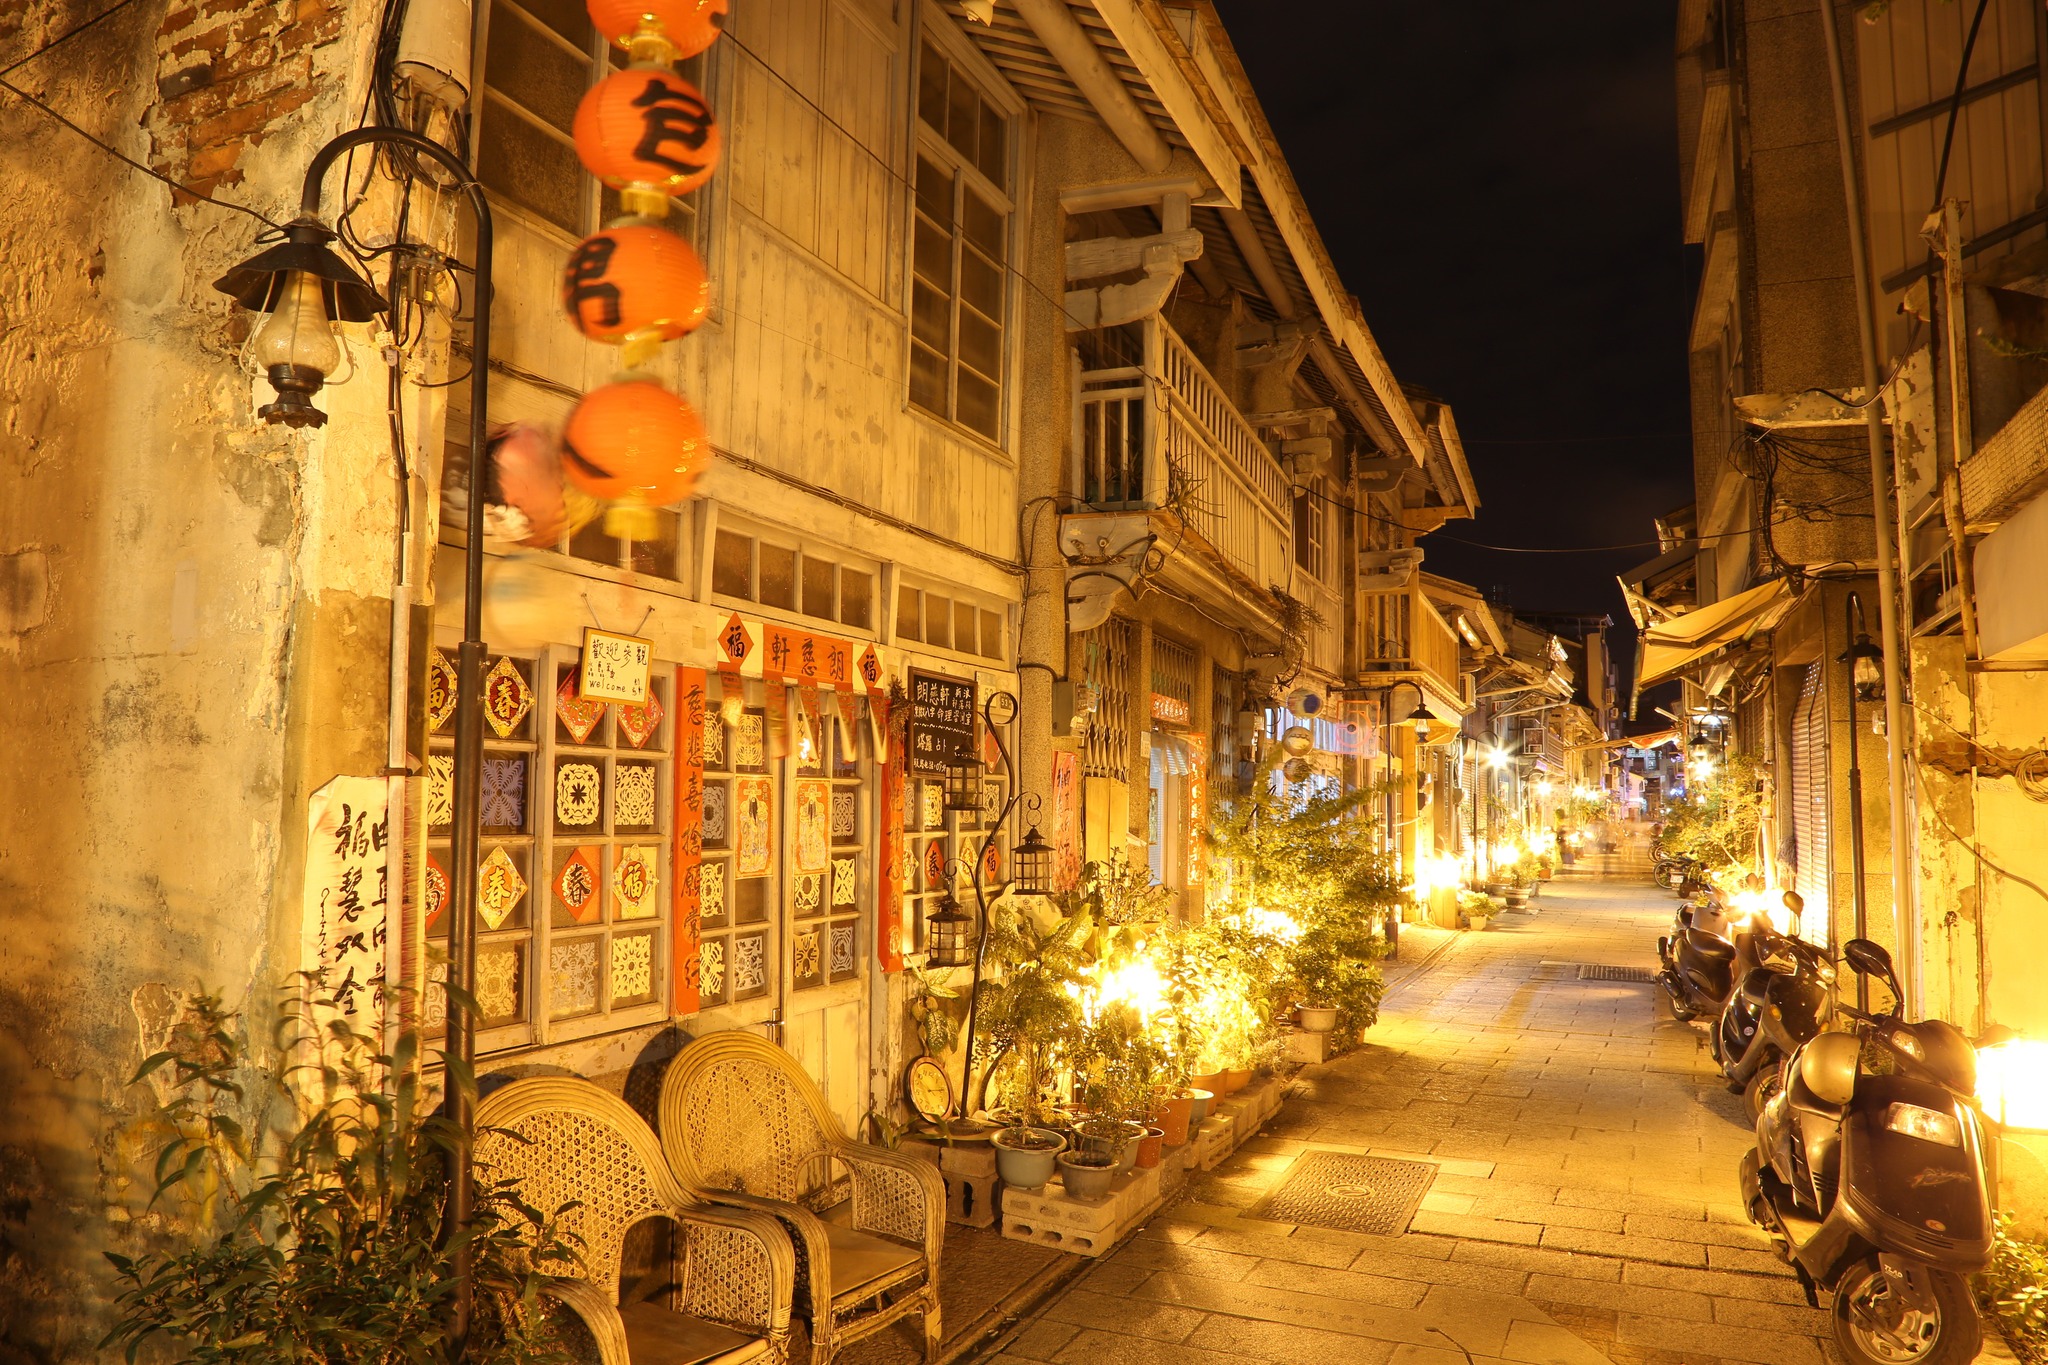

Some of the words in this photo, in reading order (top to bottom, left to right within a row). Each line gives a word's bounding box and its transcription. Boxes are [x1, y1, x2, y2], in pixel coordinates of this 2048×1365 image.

[727, 625, 746, 659] 福
[863, 654, 877, 683] 福
[494, 677, 519, 719] 春
[916, 681, 950, 706] 朗慈軒
[929, 850, 939, 877] 春
[986, 848, 997, 872] 福
[484, 866, 511, 908] 春
[568, 863, 591, 905] 春
[624, 863, 644, 898] 福
